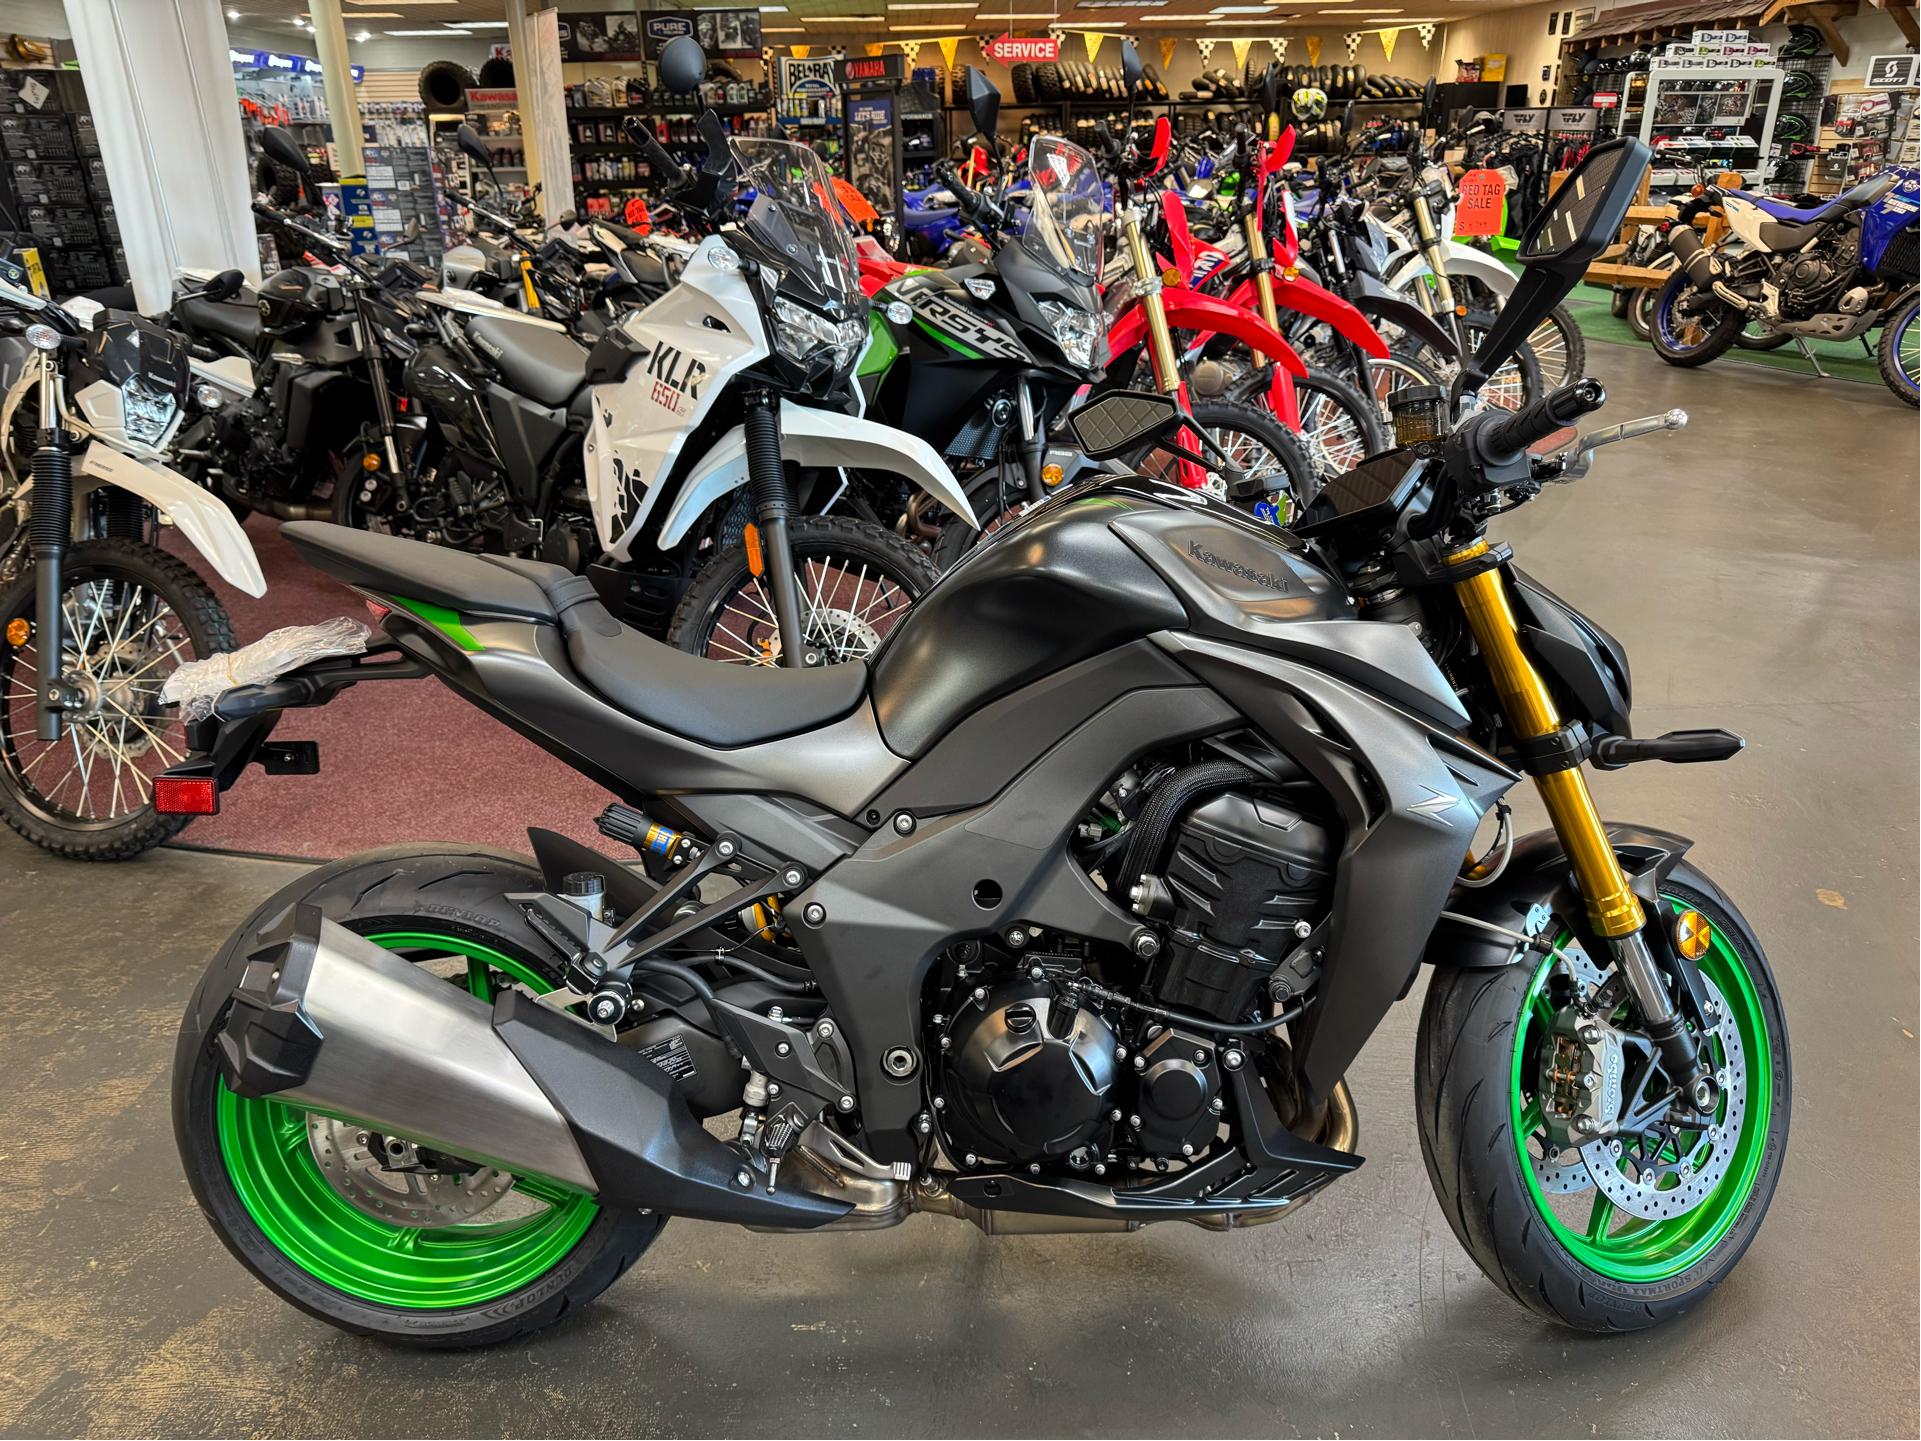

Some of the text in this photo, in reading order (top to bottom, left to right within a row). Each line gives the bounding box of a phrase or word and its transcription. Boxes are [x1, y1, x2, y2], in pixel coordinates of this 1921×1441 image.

[652, 22, 687, 32] PURE
[994, 42, 1055, 58] SERVICE
[854, 60, 886, 78] YAMAHA
[1513, 112, 1536, 124] FLY
[1561, 112, 1587, 124] FLY
[1462, 183, 1501, 196] RED TAG
[1467, 197, 1492, 210] SALE
[896, 278, 1027, 363] VERSYS
[473, 330, 504, 360] Kawasaki
[148, 371, 177, 388] Kawasaki
[647, 340, 706, 401] KLR
[651, 380, 681, 413] 650
[1187, 539, 1290, 594] Kawasaki
[1657, 883, 1701, 904] DUNLOP
[425, 903, 501, 928] DUNLOP
[1604, 1053, 1619, 1115] brembo
[515, 1265, 573, 1309] DUNLOP
[1631, 1273, 1693, 1297] SPORTMAX
